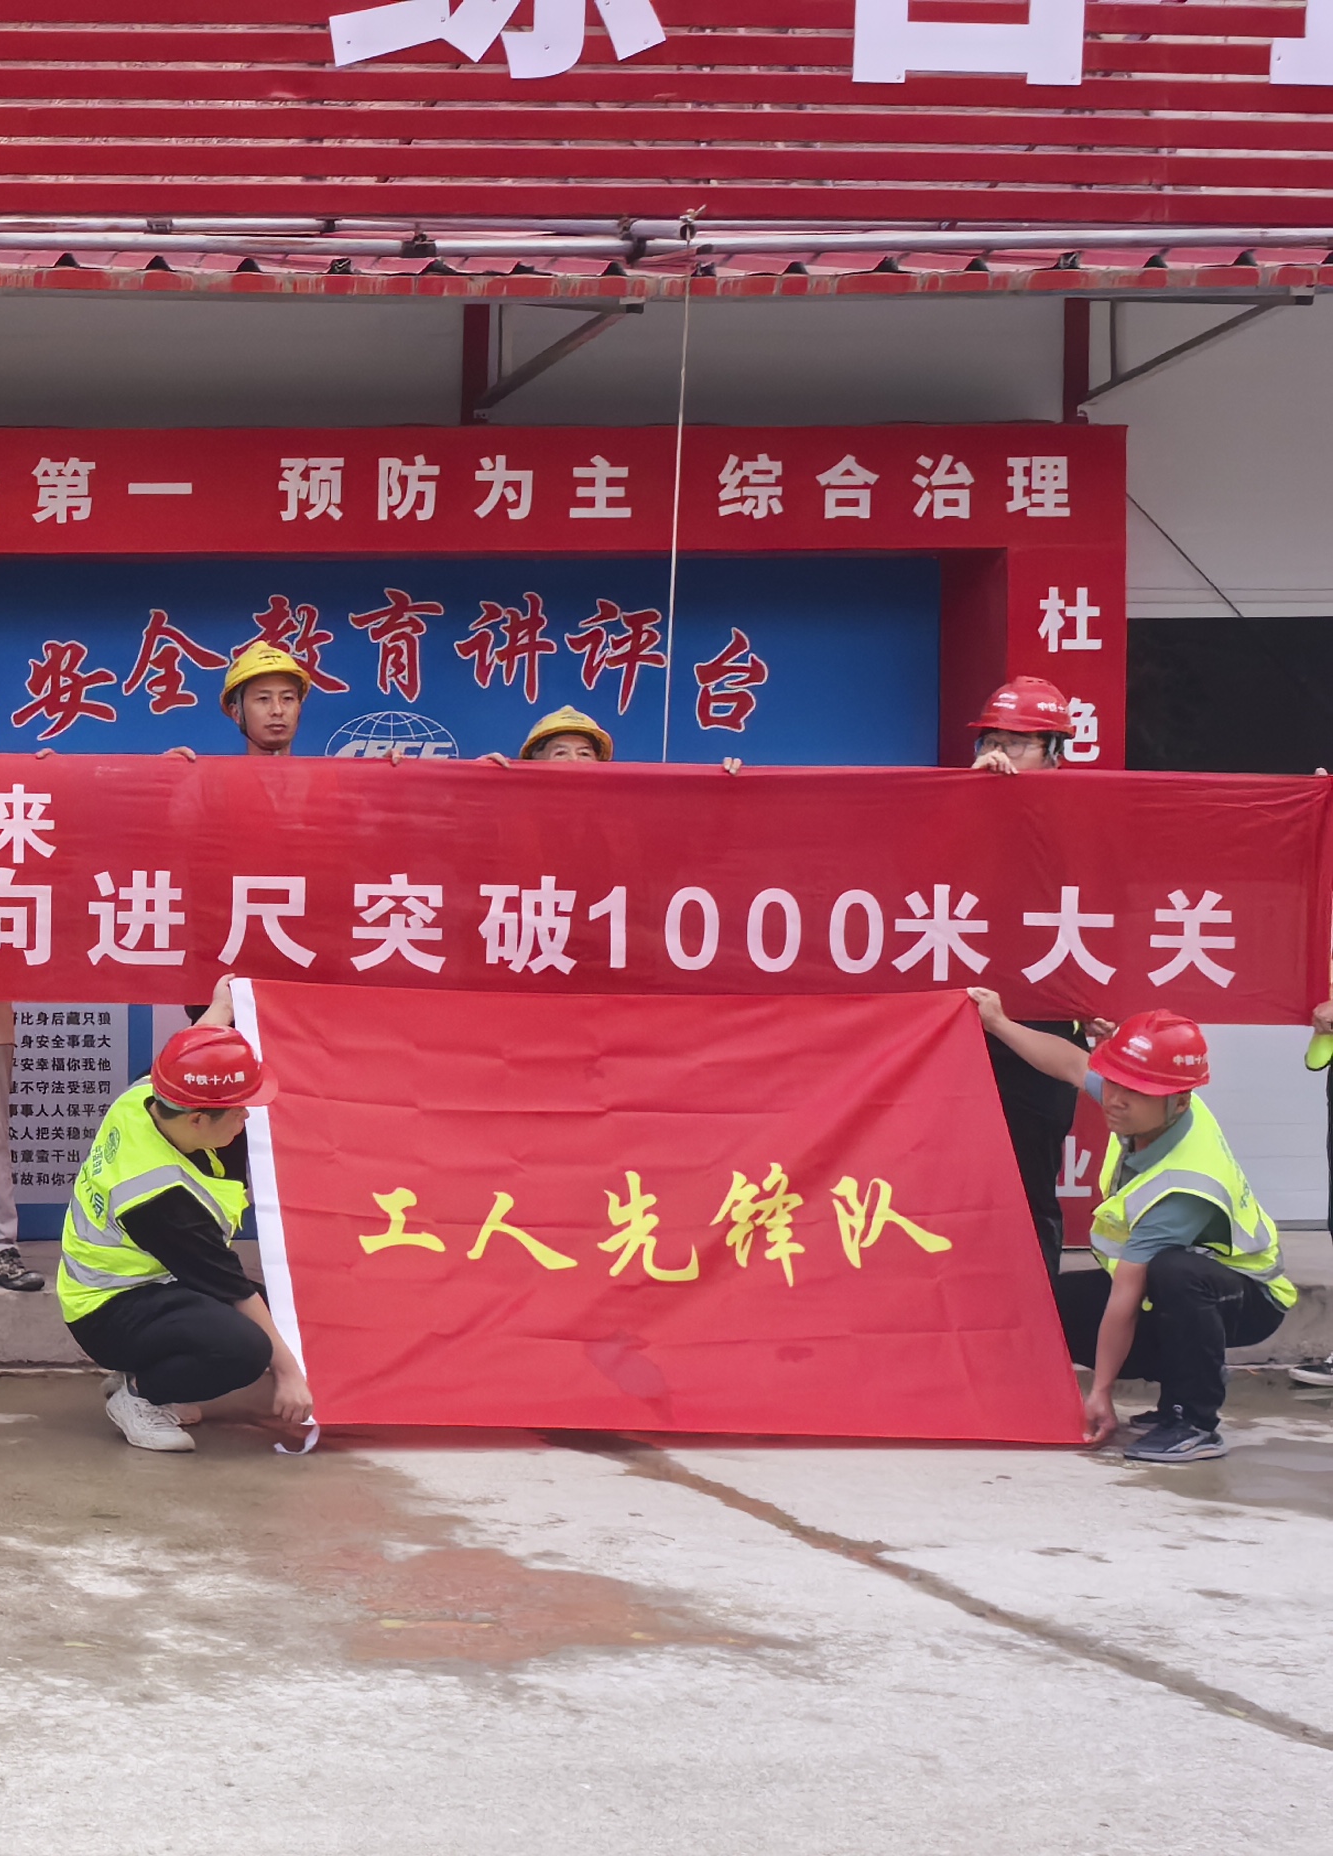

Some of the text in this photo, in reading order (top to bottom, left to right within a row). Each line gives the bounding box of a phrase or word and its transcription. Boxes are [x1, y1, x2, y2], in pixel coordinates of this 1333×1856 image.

[277, 454, 632, 522] 预防为主
[717, 453, 1071, 520] 综合治理
[11, 588, 768, 741] 安全教育讲评台
[13, 1011, 111, 1026] 比身后藏只狼
[183, 1070, 245, 1086] 中铁十八局
[358, 1162, 952, 1287] 工人先锋队
